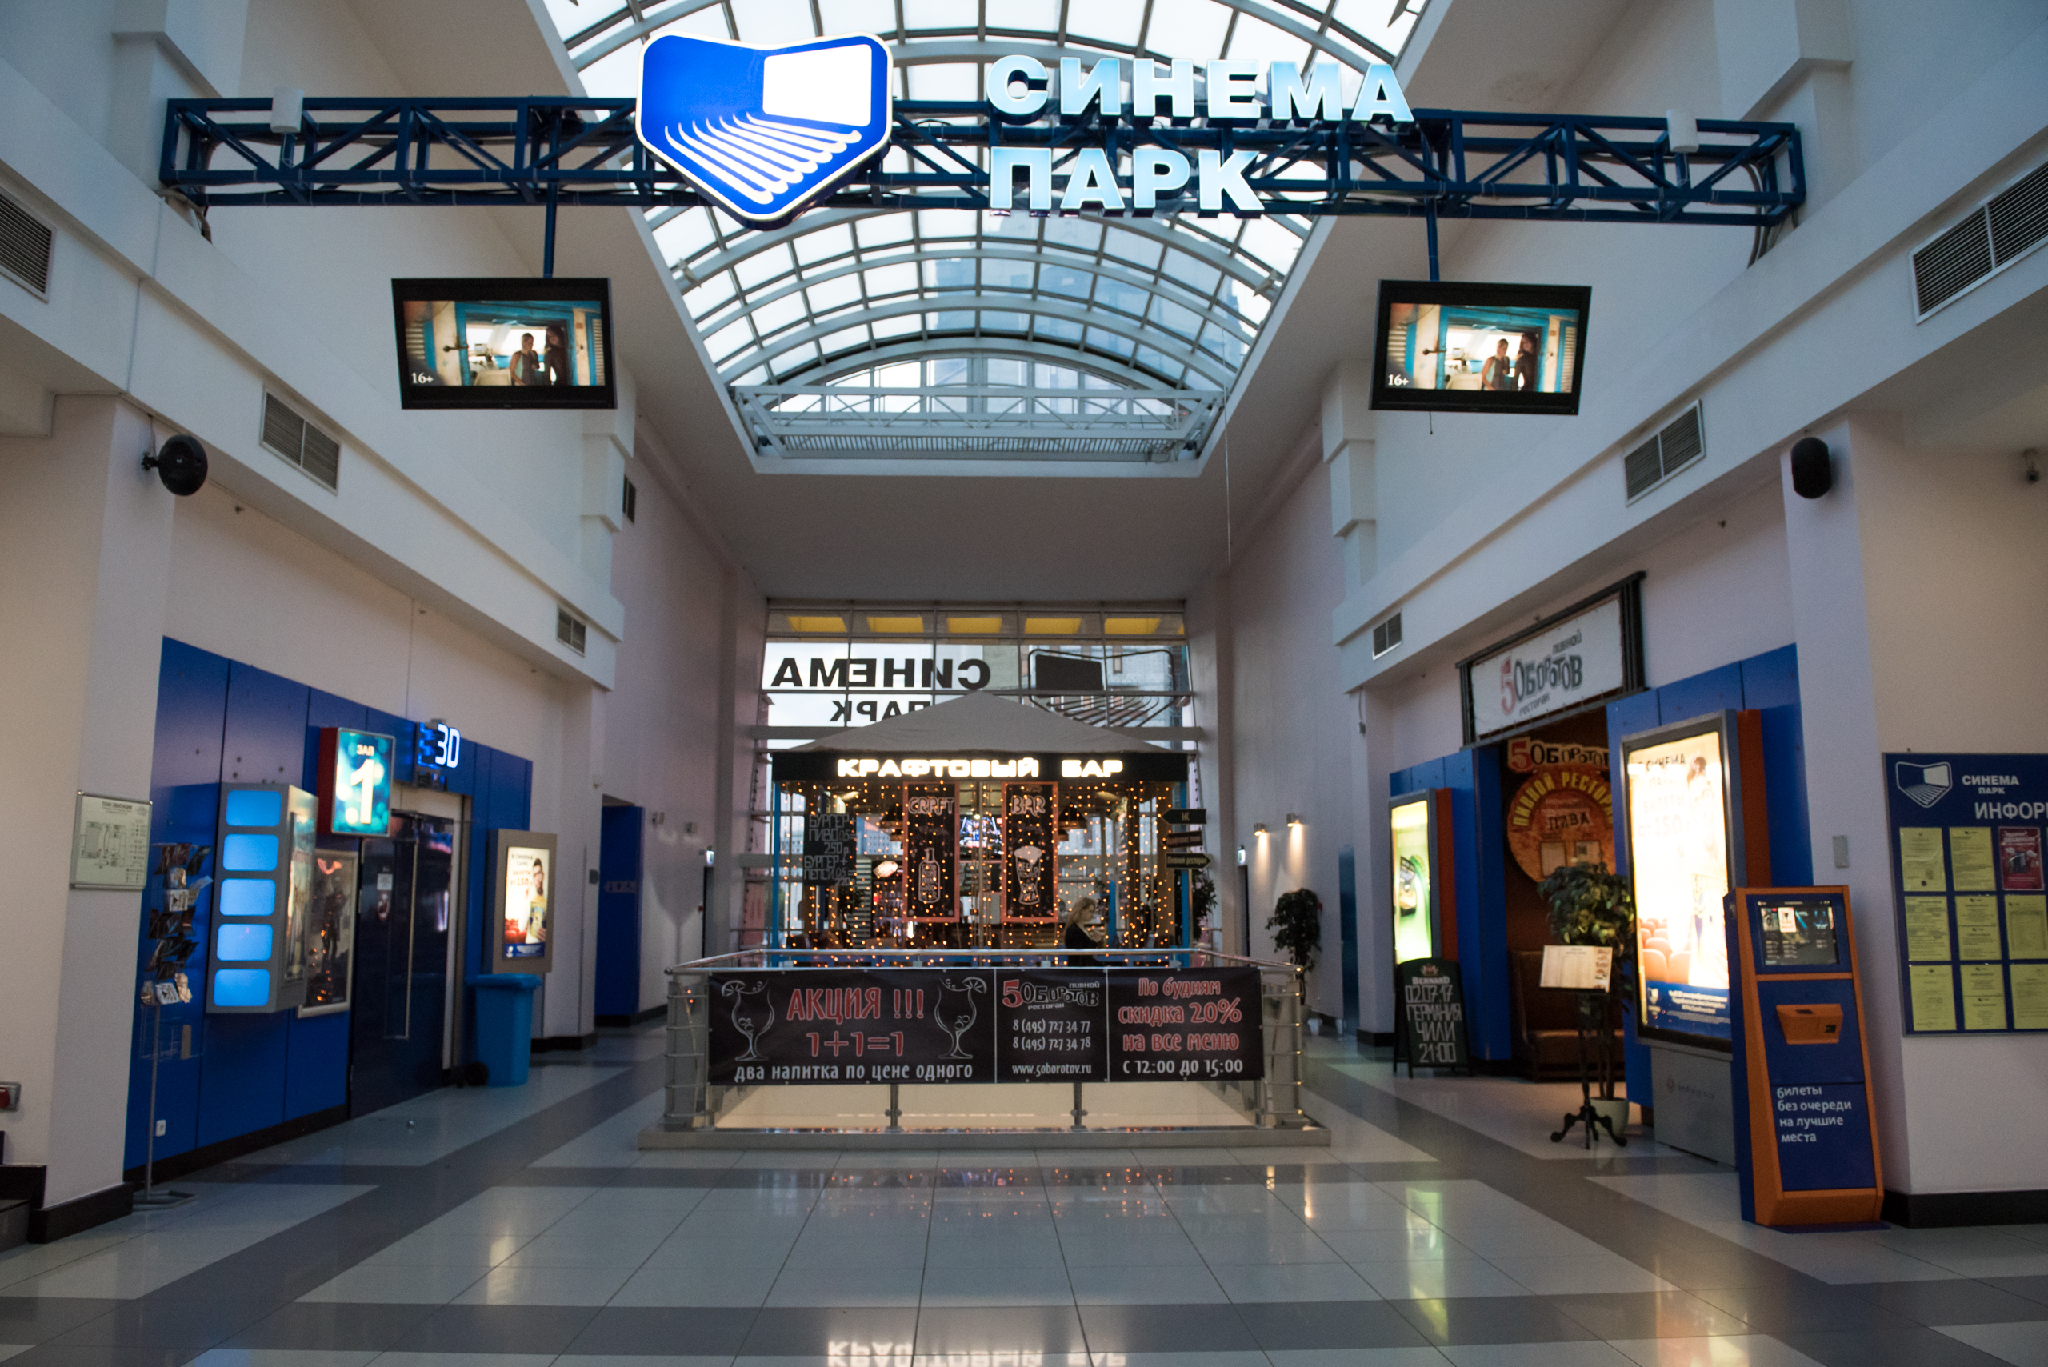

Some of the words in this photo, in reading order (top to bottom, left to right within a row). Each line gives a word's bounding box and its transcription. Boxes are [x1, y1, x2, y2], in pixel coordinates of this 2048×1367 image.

[985, 54, 1416, 126] СИНЕМА
[988, 146, 1266, 214] ПАРК
[410, 371, 435, 384] 16+
[1387, 373, 1410, 387] 16+
[356, 744, 375, 757] ЗАЛ
[434, 722, 462, 769] 3D
[837, 757, 1039, 778] КРАФТОВЫЙ
[1061, 759, 1123, 778] БАР
[1961, 775, 2020, 786] СИНЕМА
[350, 758, 375, 825] 1
[1977, 787, 2006, 795] ПАРК
[1974, 801, 2048, 820] ИНФОР
[1138, 978, 1158, 996] По
[1162, 977, 1222, 1000] будням
[786, 987, 882, 1025] АКЦИЯ
[1118, 1004, 1185, 1027] скидка
[1189, 997, 1243, 1024] 20%
[1013, 1019, 1019, 1031] 8
[1021, 1018, 1047, 1033] (495)
[1049, 1020, 1064, 1033] 727
[1066, 1020, 1078, 1033] 34
[1081, 1019, 1091, 1033] 77
[1415, 1020, 1456, 1042] ЧИЛИ
[806, 1030, 904, 1057] 1+1=1
[1013, 1036, 1019, 1049] 8
[1021, 1036, 1047, 1051] (495)
[1049, 1038, 1064, 1051] 727
[1066, 1038, 1078, 1051] 34
[1081, 1036, 1091, 1050] 78
[1122, 1034, 1146, 1051] на
[1152, 1033, 1182, 1051] все
[1187, 1032, 1240, 1051] меню
[734, 1066, 764, 1083] два
[771, 1065, 839, 1080] напитка
[845, 1065, 865, 1079] по
[872, 1064, 911, 1082] цене
[916, 1064, 974, 1082] одного
[1136, 1060, 1175, 1074] 12:00
[1205, 1059, 1243, 1077] 15:00
[1777, 1086, 1823, 1099] билеты
[1777, 1100, 1798, 1111] без
[1800, 1101, 1852, 1114] очереди
[1779, 1118, 1795, 1127] на
[1797, 1116, 1844, 1130] лучшие
[1781, 1132, 1817, 1142] места
